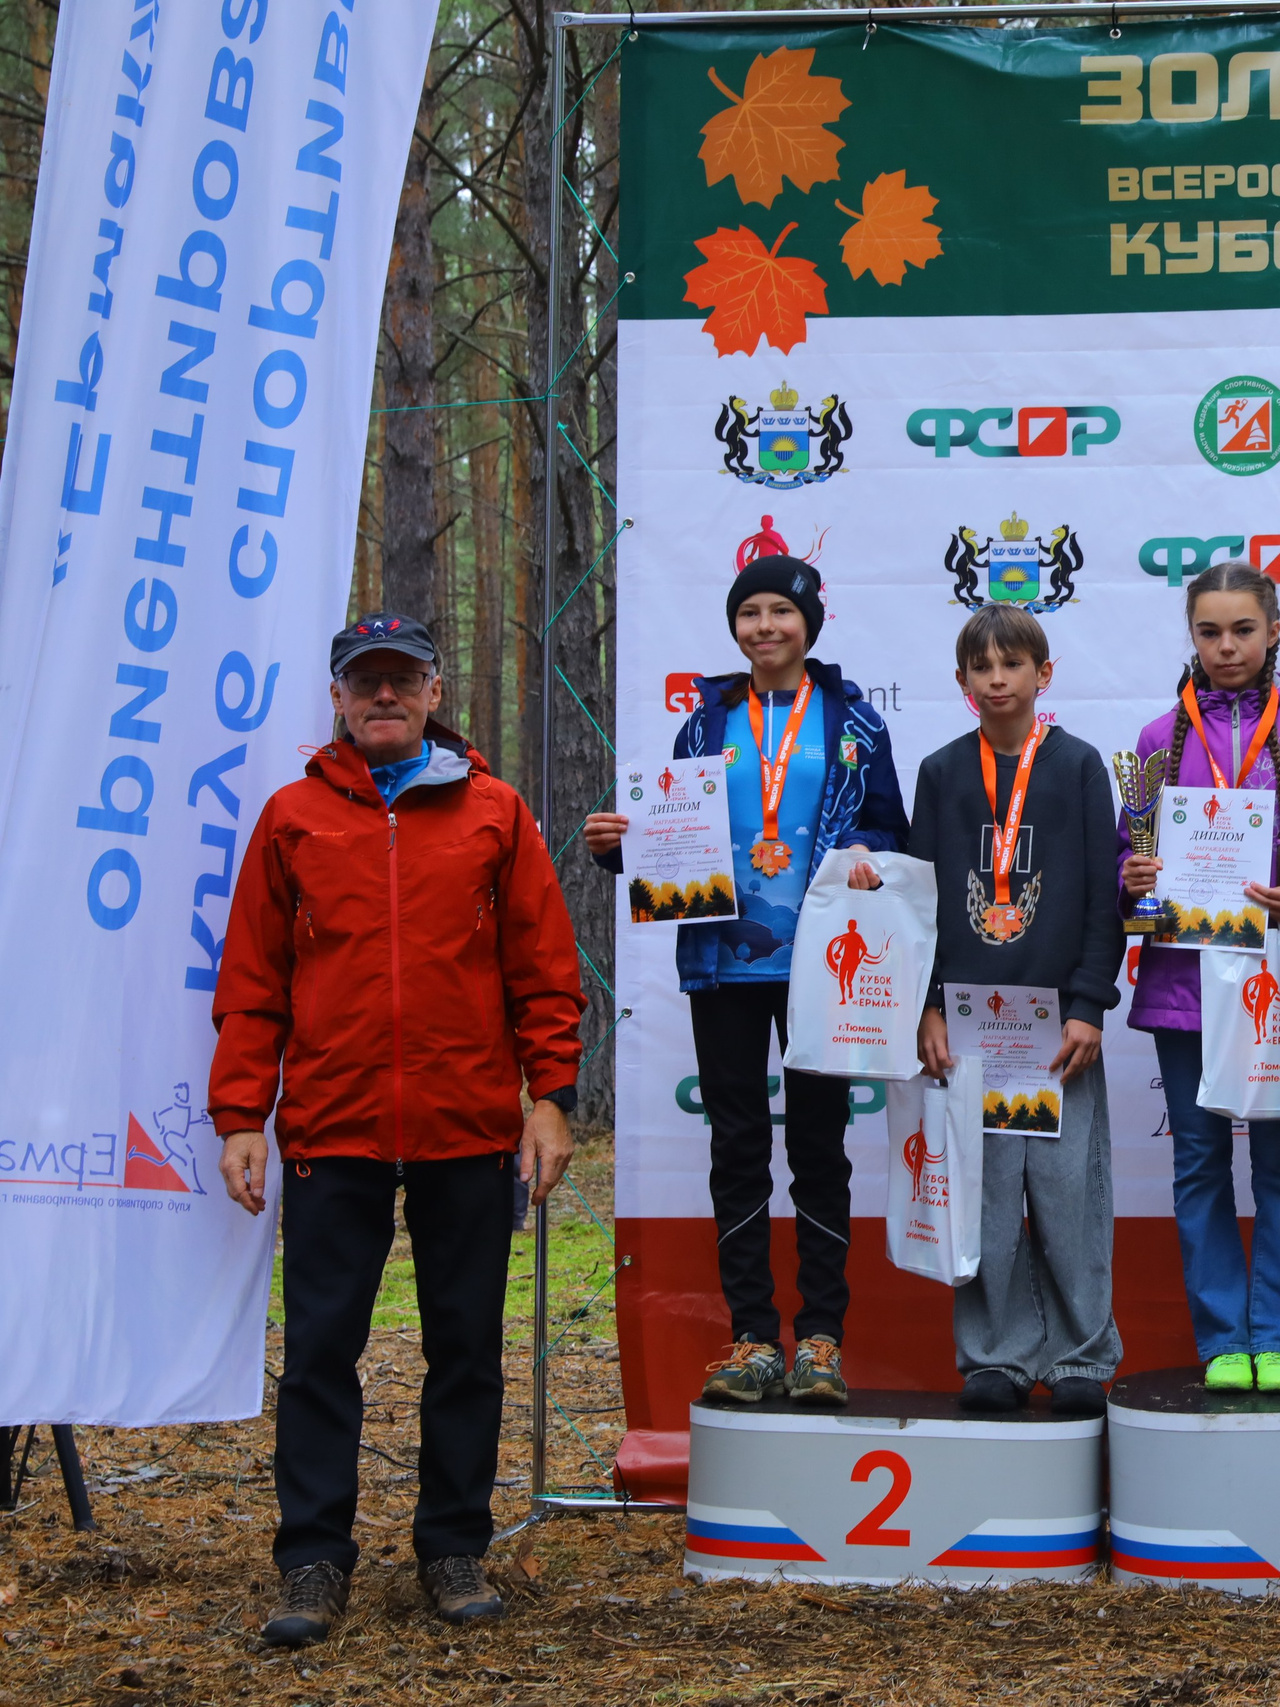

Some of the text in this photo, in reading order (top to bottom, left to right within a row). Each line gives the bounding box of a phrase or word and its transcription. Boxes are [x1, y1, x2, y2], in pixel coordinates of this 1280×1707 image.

[1224, 379, 1274, 396] СПОРТИВНОГО
[1198, 389, 1222, 429] ФЕДЕРАЦИЯ
[1199, 432, 1219, 462] ОБЛАСТИ
[1222, 461, 1267, 473] ТЮМЕНСКОЙ
[1021, 736, 1037, 769] ТЮМЕНЬ
[768, 783, 780, 811] КУБОК
[774, 765, 784, 782] КСО
[648, 801, 702, 817] ДИПЛОМ
[1004, 827, 1014, 845] КСО
[1189, 830, 1245, 842] ДИПЛОМ
[774, 845, 784, 856] 2
[999, 846, 1011, 875] КУБОК
[1006, 909, 1016, 920] 2
[860, 975, 892, 985] КУБОК
[859, 987, 882, 996] КСО
[852, 998, 900, 1009] «ЕРМАК»
[838, 1023, 883, 1034] г.Тюмень
[977, 1021, 1033, 1031] ДИПЛОМ
[832, 1034, 888, 1046] orienteer.ru
[844, 1449, 914, 1547] 2
